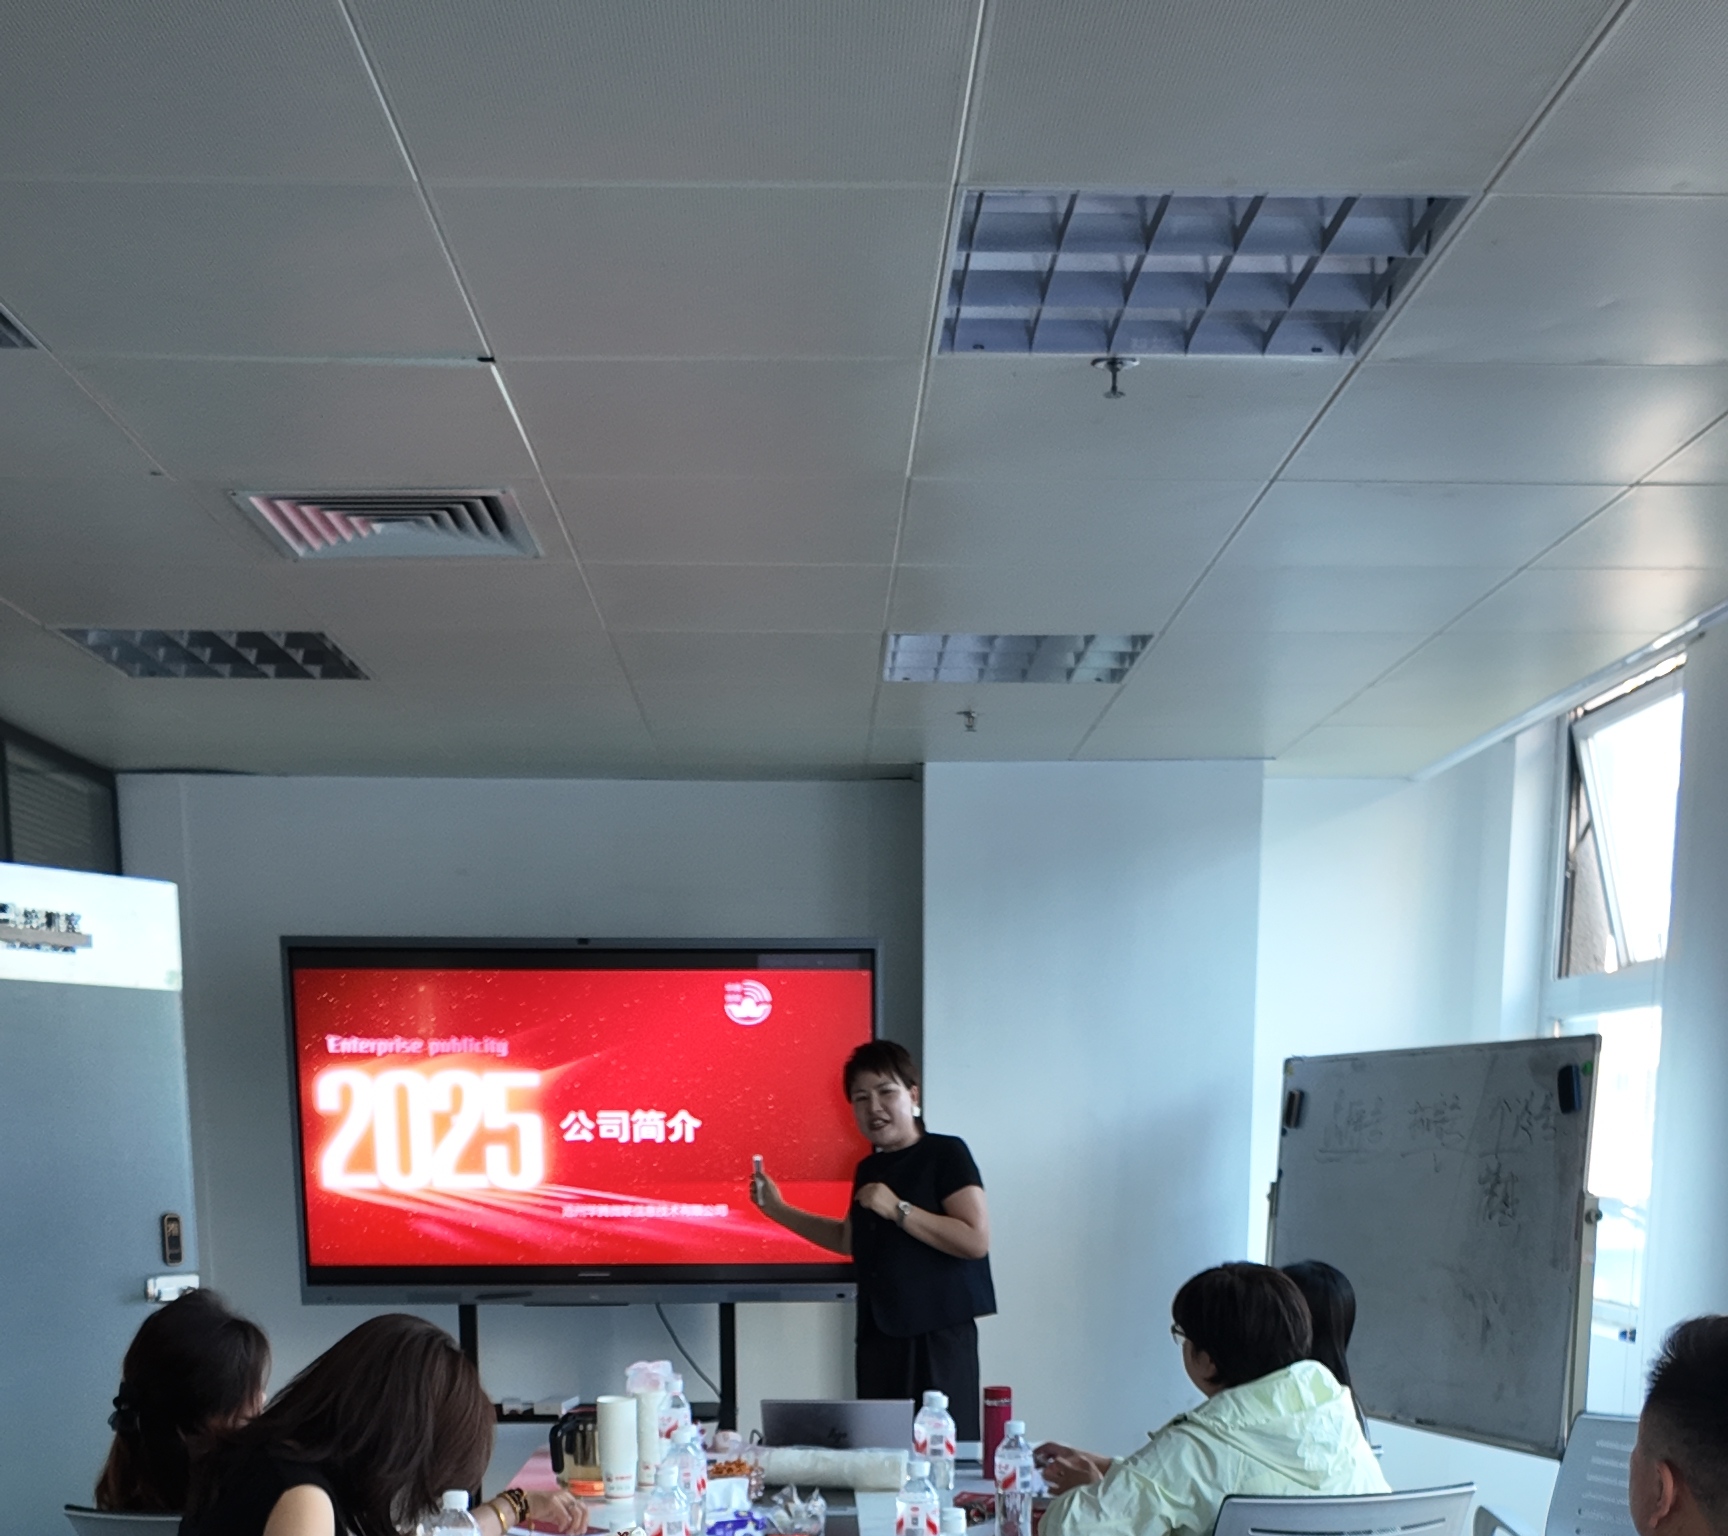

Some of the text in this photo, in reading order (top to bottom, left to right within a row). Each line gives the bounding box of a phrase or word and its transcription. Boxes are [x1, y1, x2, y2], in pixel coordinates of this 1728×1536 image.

[325, 1034, 510, 1058] Enterprise publicity
[315, 1068, 544, 1191] 2025
[559, 1109, 702, 1143] 公司简介
